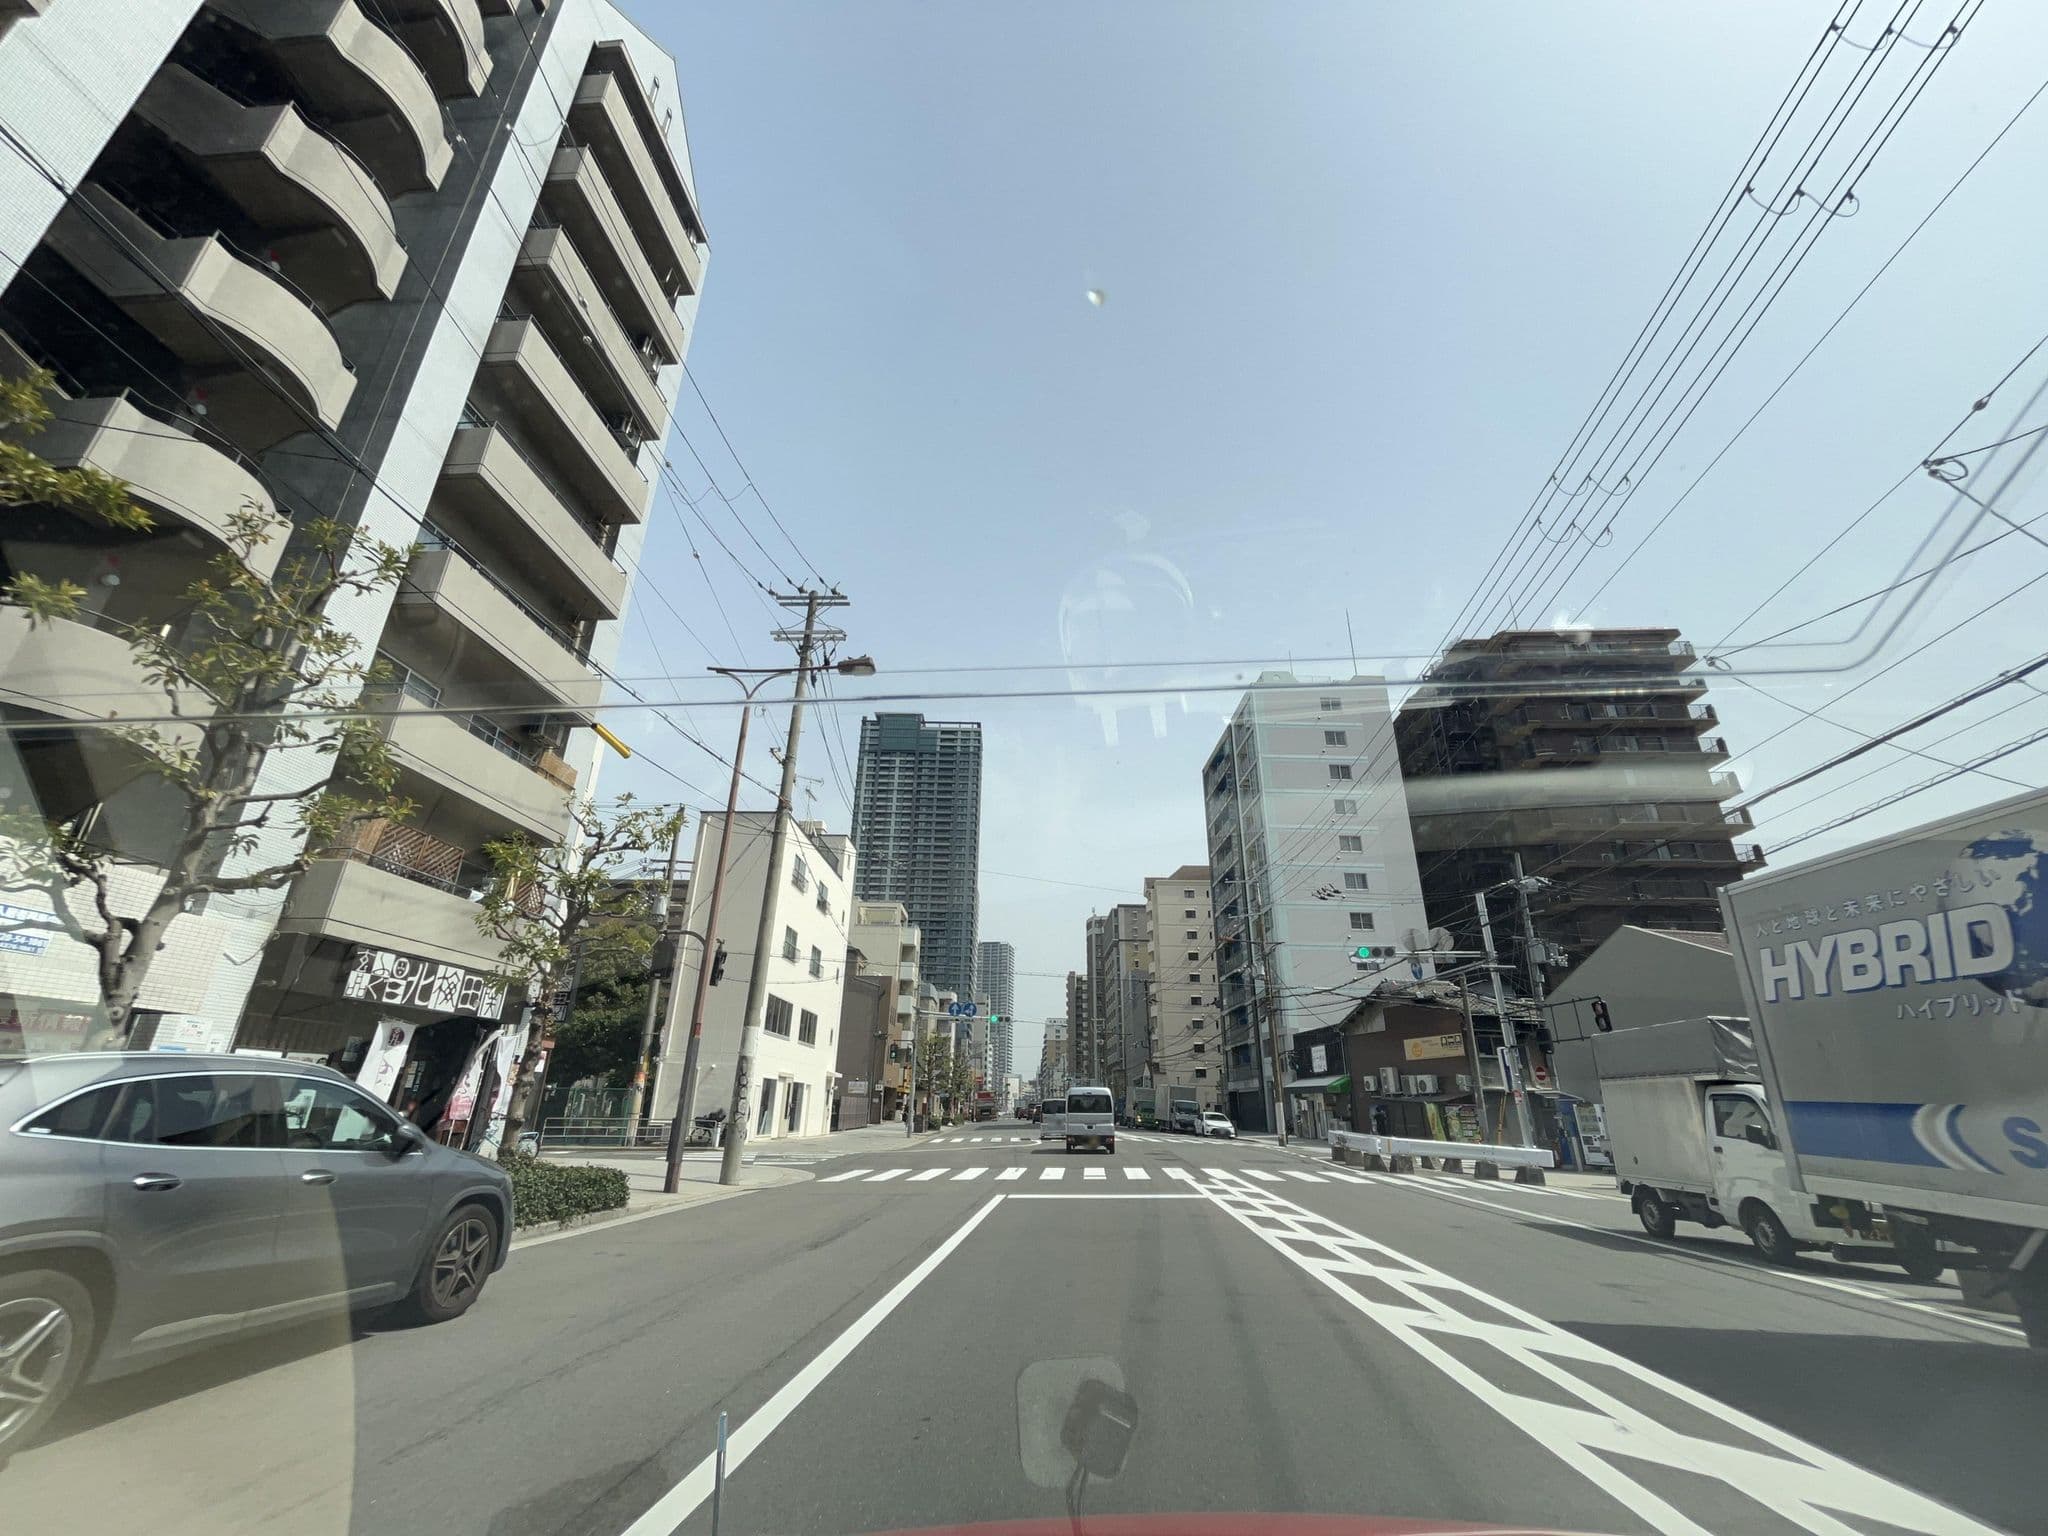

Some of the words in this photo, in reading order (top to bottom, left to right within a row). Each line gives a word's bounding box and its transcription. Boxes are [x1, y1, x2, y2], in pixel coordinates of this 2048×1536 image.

[1755, 868, 2001, 939] 人と地球と未来にやさしい
[1759, 902, 2015, 1003] HYBRID
[1897, 988, 2026, 1020] ハイブリッド
